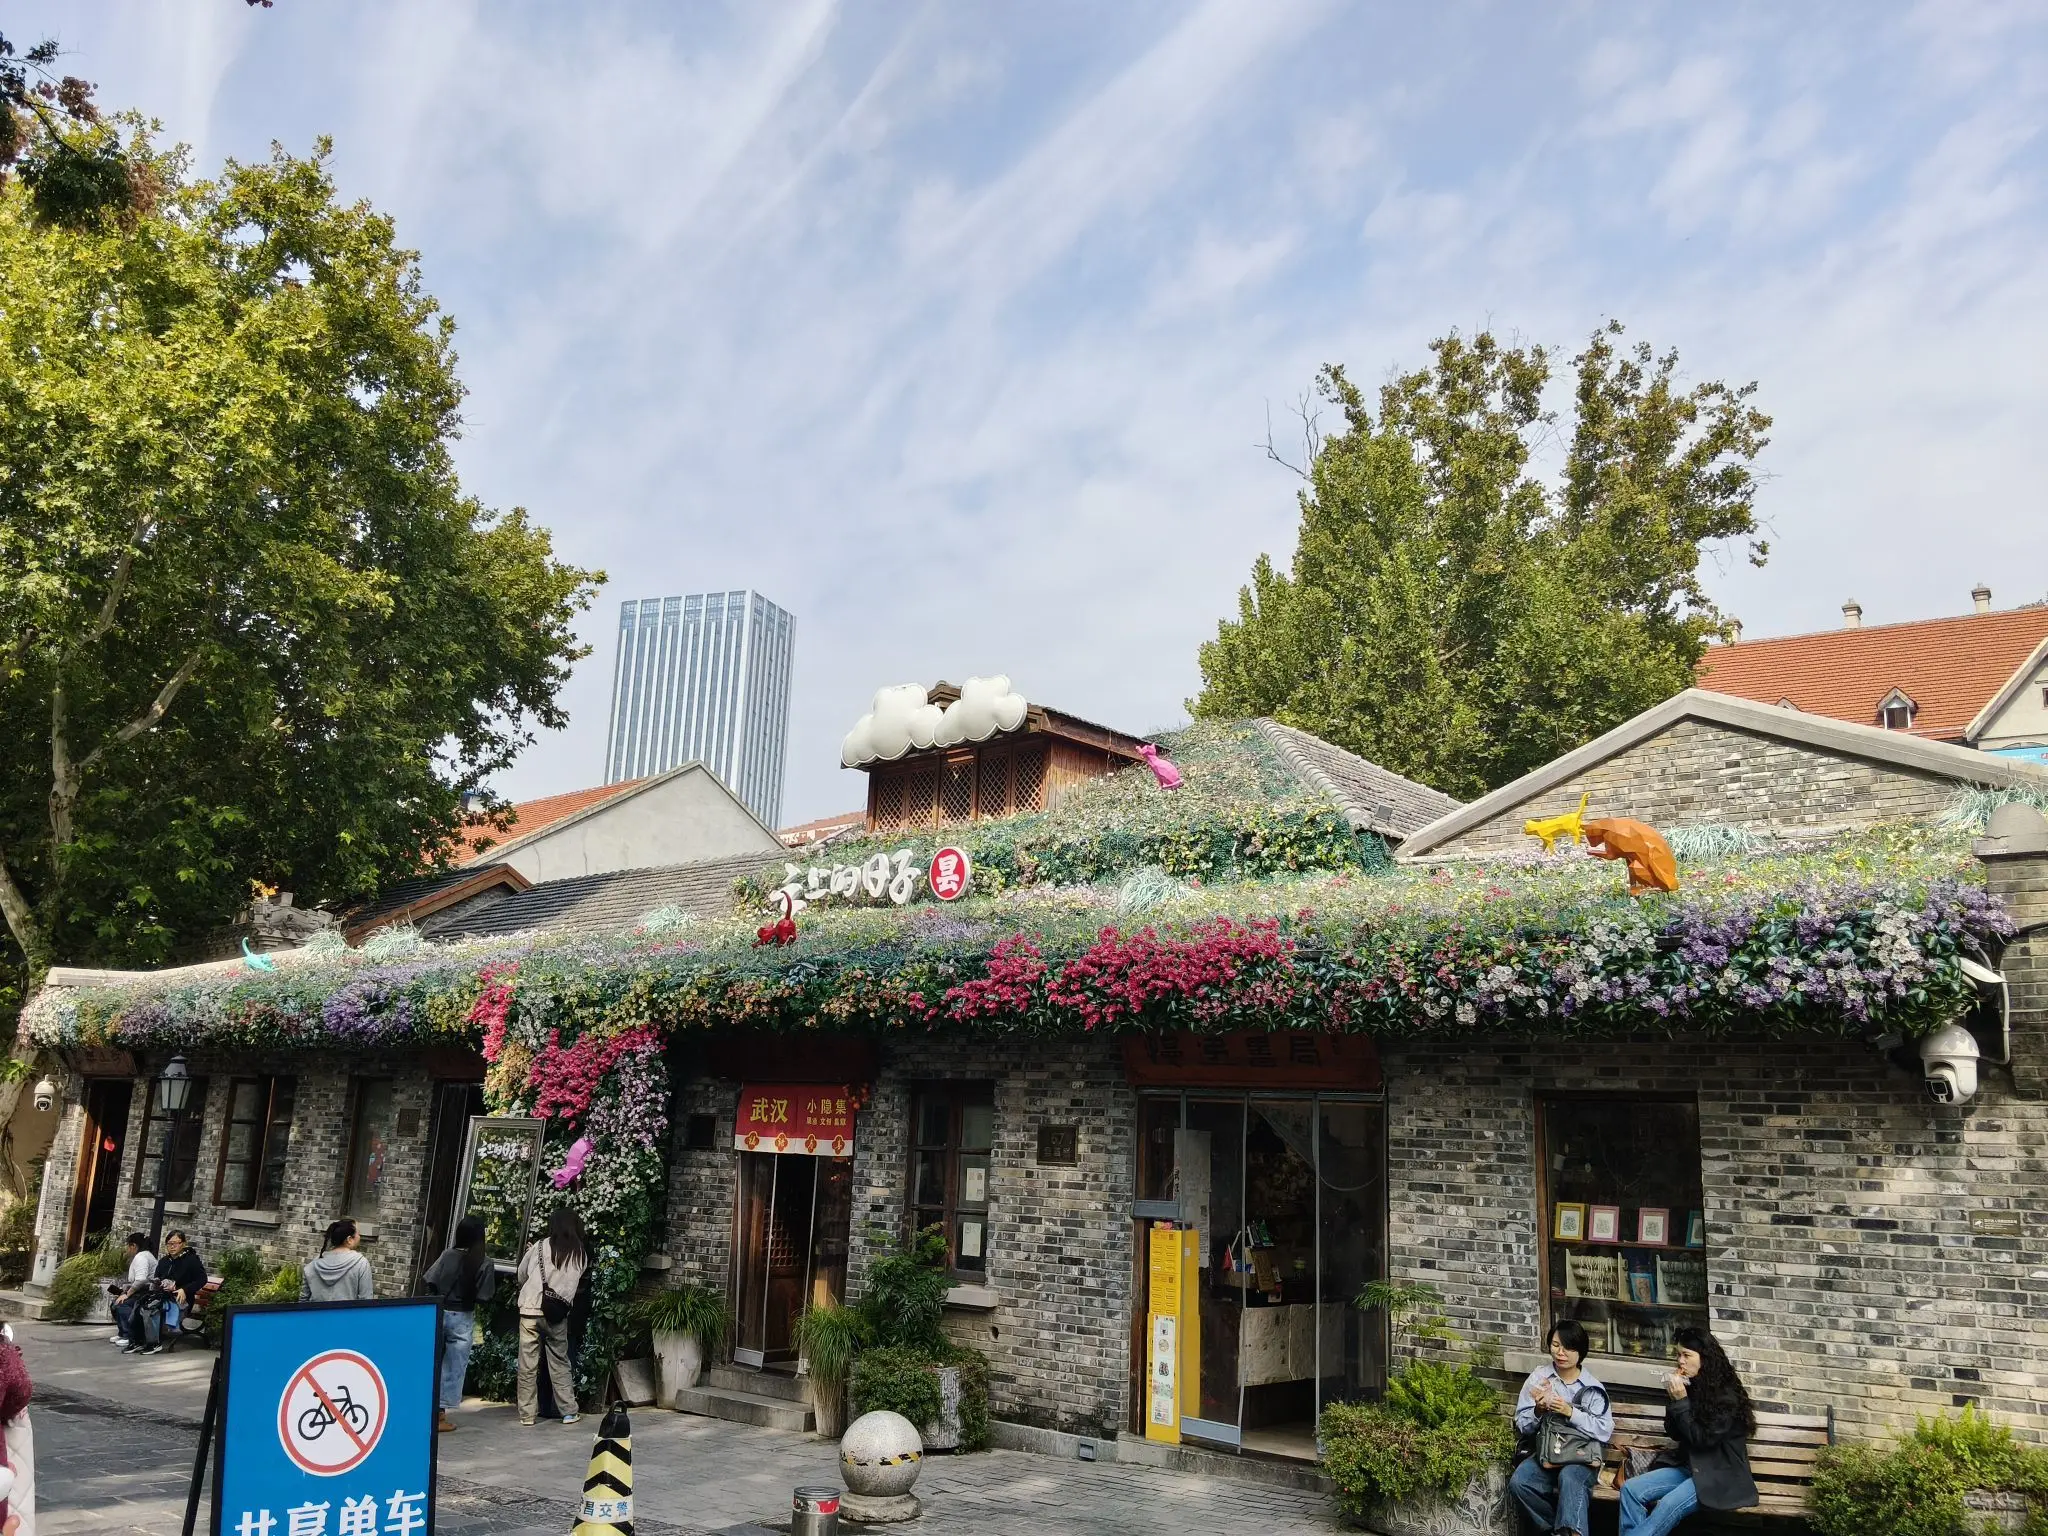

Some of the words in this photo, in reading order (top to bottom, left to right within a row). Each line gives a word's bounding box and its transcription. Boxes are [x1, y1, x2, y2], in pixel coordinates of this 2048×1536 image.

[936, 854, 960, 893] 昙
[750, 1097, 789, 1124] 武汉
[806, 1098, 847, 1115] 小隐集
[580, 1497, 628, 1517] 昌交警
